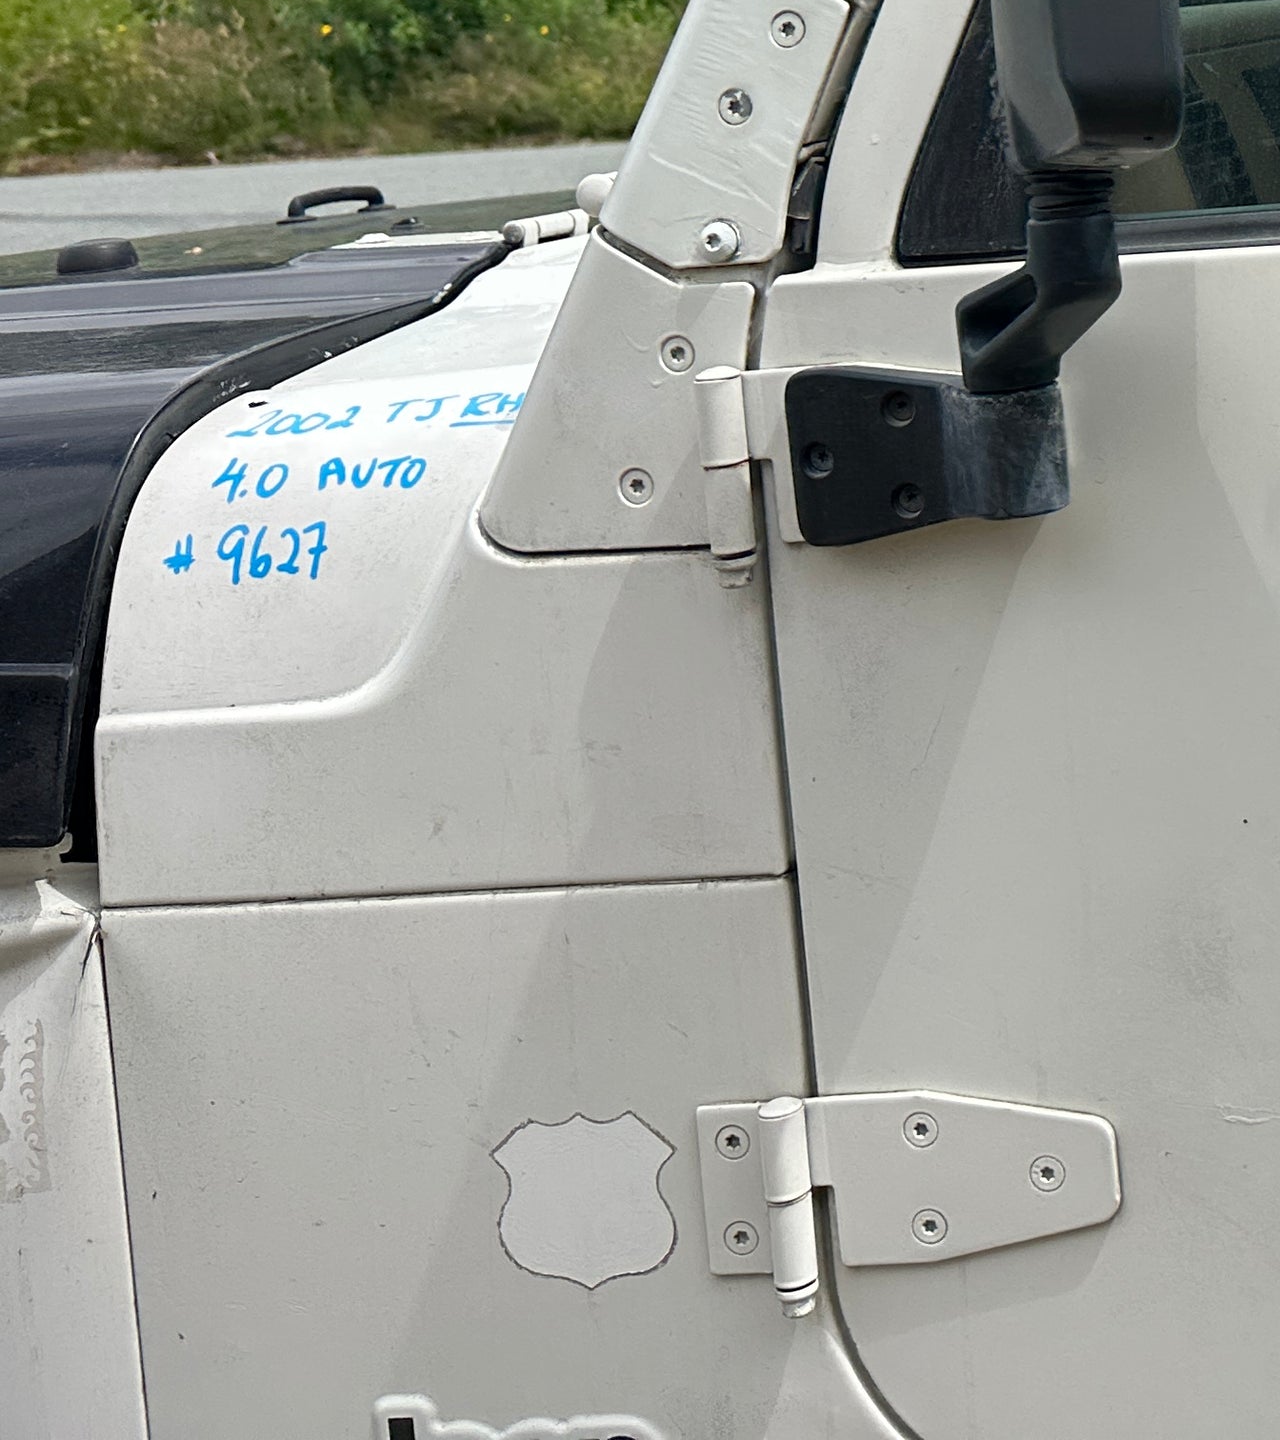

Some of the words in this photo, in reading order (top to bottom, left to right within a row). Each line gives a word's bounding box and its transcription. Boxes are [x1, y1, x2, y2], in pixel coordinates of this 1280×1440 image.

[227, 405, 362, 438] 2002
[387, 394, 460, 423] TJ
[459, 391, 526, 420] RH
[211, 457, 290, 504] 4.0
[317, 455, 428, 492] AUTO
